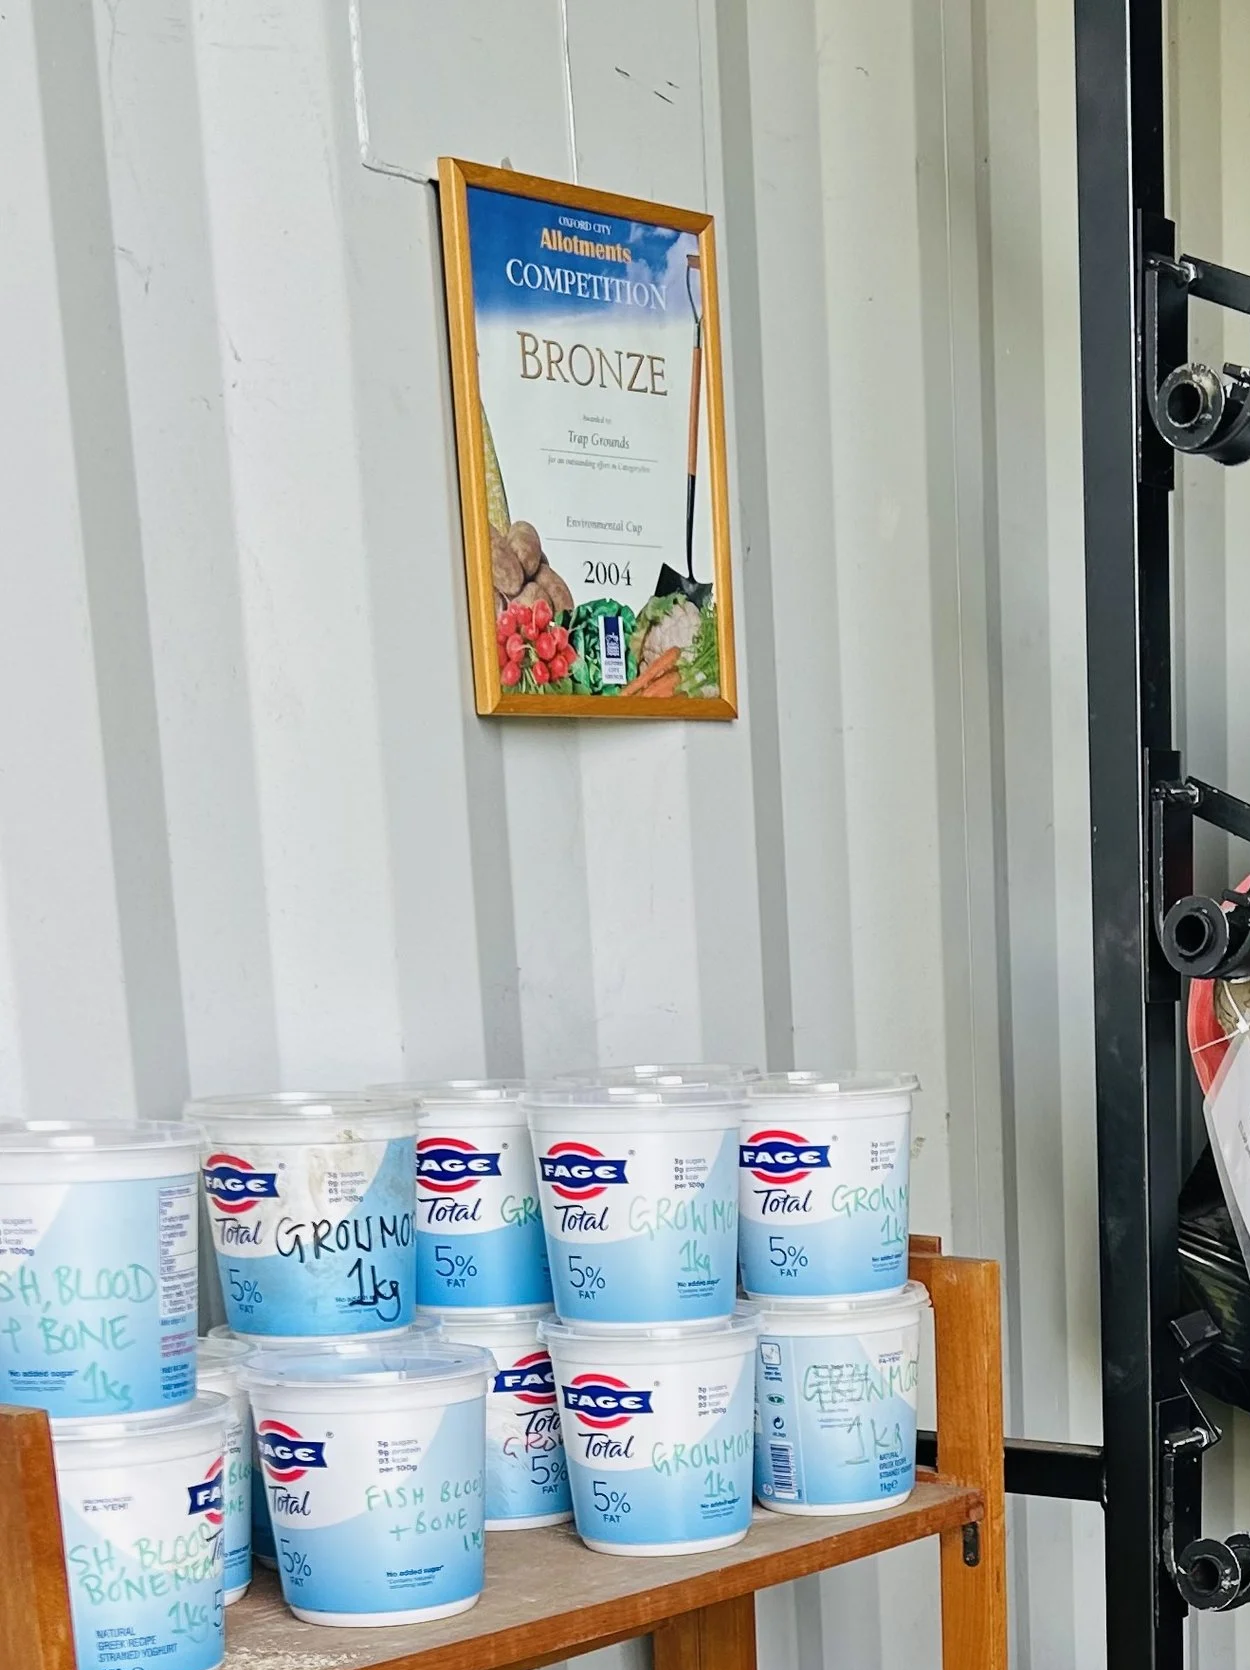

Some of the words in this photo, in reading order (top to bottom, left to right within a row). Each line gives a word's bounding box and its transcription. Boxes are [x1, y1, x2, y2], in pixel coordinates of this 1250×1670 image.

[558, 215, 592, 231] OXFORD
[593, 223, 612, 235] CITY
[540, 228, 632, 264] Allotments
[506, 258, 667, 311] COMPETITION
[516, 330, 668, 396] BRONZE
[568, 430, 589, 448] Trap
[591, 433, 630, 449] Grounds
[566, 515, 624, 532] Environmental
[626, 520, 643, 536] Cup
[583, 560, 634, 587] 2004
[743, 1150, 822, 1165] FAGE
[205, 1176, 269, 1193] FAGE
[543, 1164, 619, 1180] FAGE
[418, 1197, 482, 1225] Total
[753, 1189, 813, 1216] Total
[215, 1218, 263, 1246] Total
[554, 1204, 609, 1233] Total
[435, 1245, 478, 1278] 5%
[769, 1236, 809, 1268] 5%
[53, 1263, 158, 1306] BLOOD
[228, 1268, 263, 1303] 5%
[446, 1279, 466, 1288] FAT
[568, 1255, 606, 1290] 5%
[780, 1269, 798, 1278] FAT
[347, 1257, 402, 1323] 1kg
[579, 1291, 597, 1300] FAT
[38, 1314, 137, 1355] BONE
[567, 1393, 644, 1409] FAGE
[578, 1432, 635, 1460] Total
[268, 1485, 312, 1517] Total
[364, 1484, 426, 1513] FISH
[542, 1484, 559, 1494] FAT
[593, 1480, 631, 1514] 5%
[414, 1507, 469, 1534] BONE
[603, 1514, 622, 1524] FAT
[136, 1521, 211, 1573] BLOOD
[280, 1537, 313, 1578] 5%
[399, 1568, 423, 1577] added
[96, 1626, 136, 1639] NATURAL
